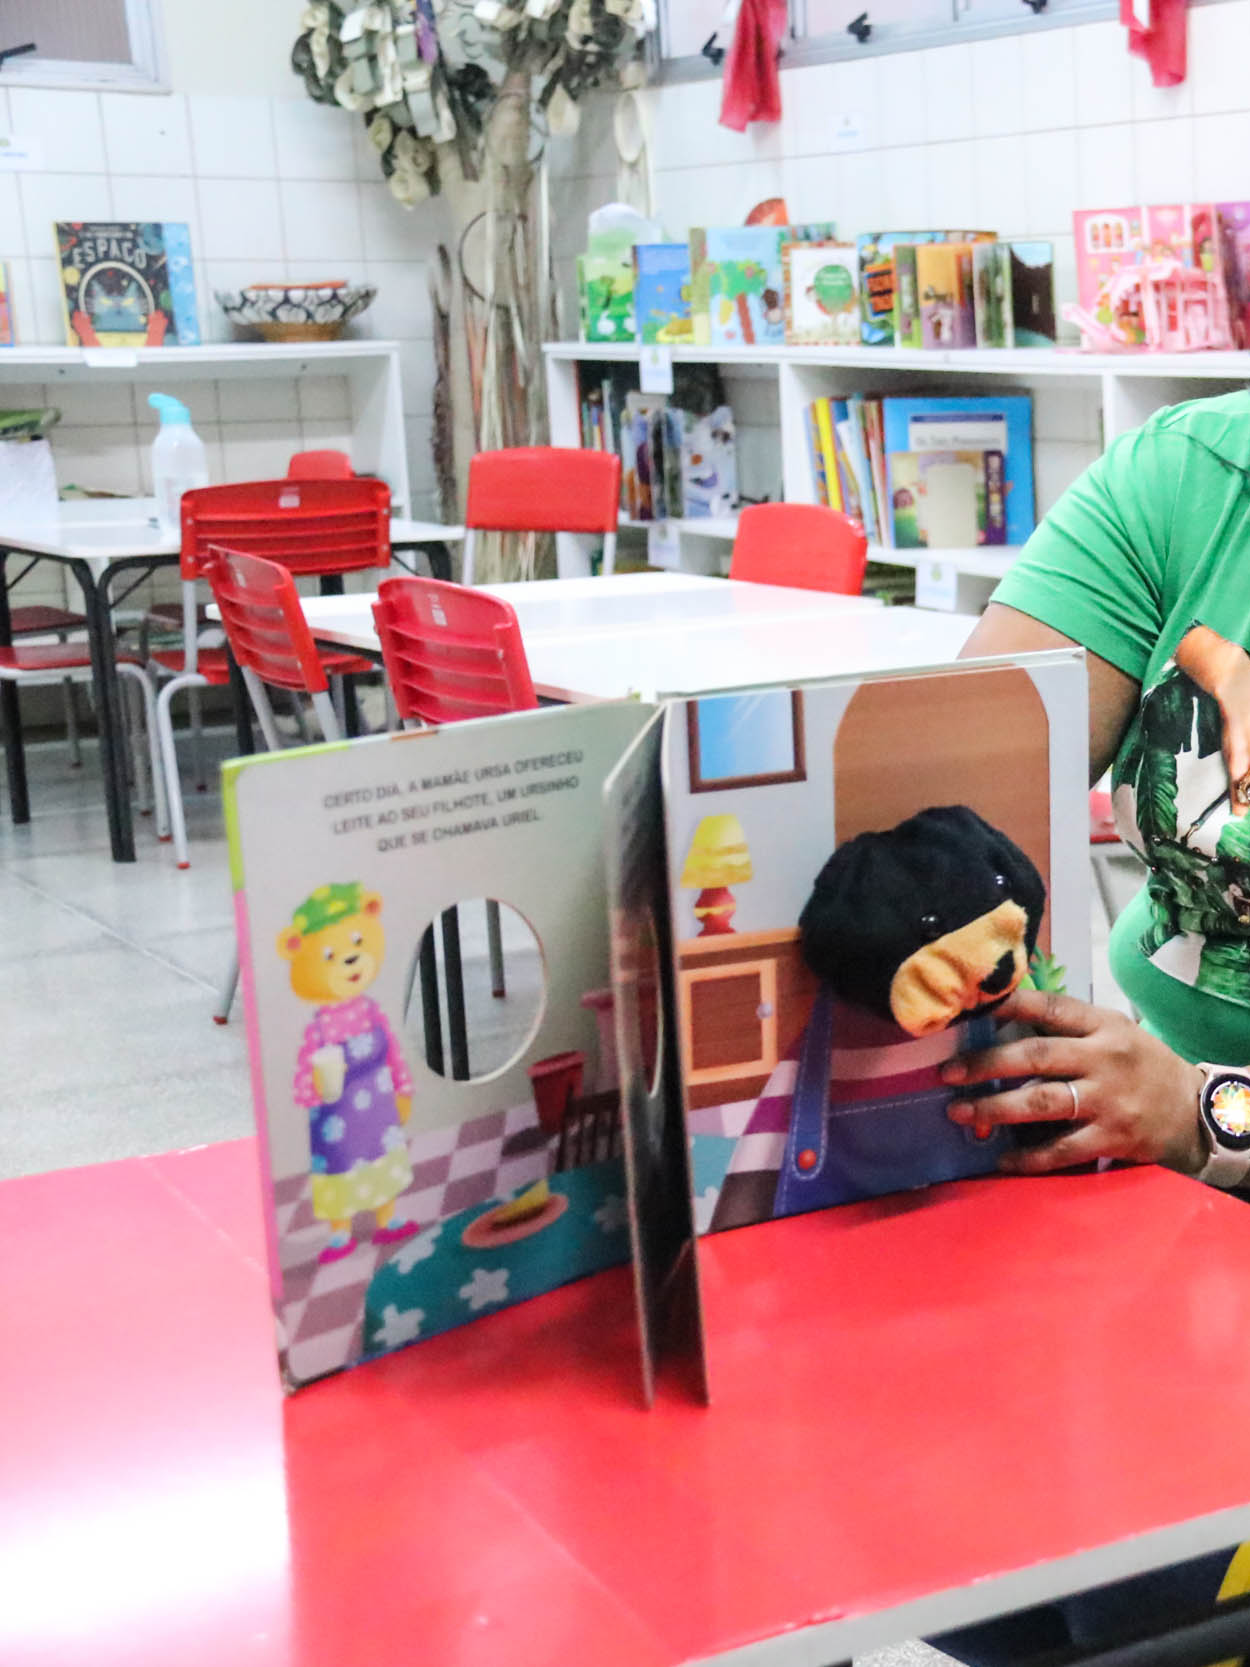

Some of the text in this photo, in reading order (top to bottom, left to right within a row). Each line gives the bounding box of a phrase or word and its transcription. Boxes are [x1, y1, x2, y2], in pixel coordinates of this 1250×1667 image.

[323, 787, 374, 809] CERTO
[408, 780, 418, 793] A
[474, 763, 511, 782] URSA
[514, 750, 584, 774] OFERECEU
[333, 814, 372, 835] LEITE
[377, 809, 399, 825] AO
[400, 803, 430, 822] SEU
[496, 788, 517, 803] UM
[520, 775, 580, 798] URSINHO
[377, 836, 406, 852] QUE
[411, 830, 427, 845] SE
[432, 817, 498, 842] CHAMAVA
